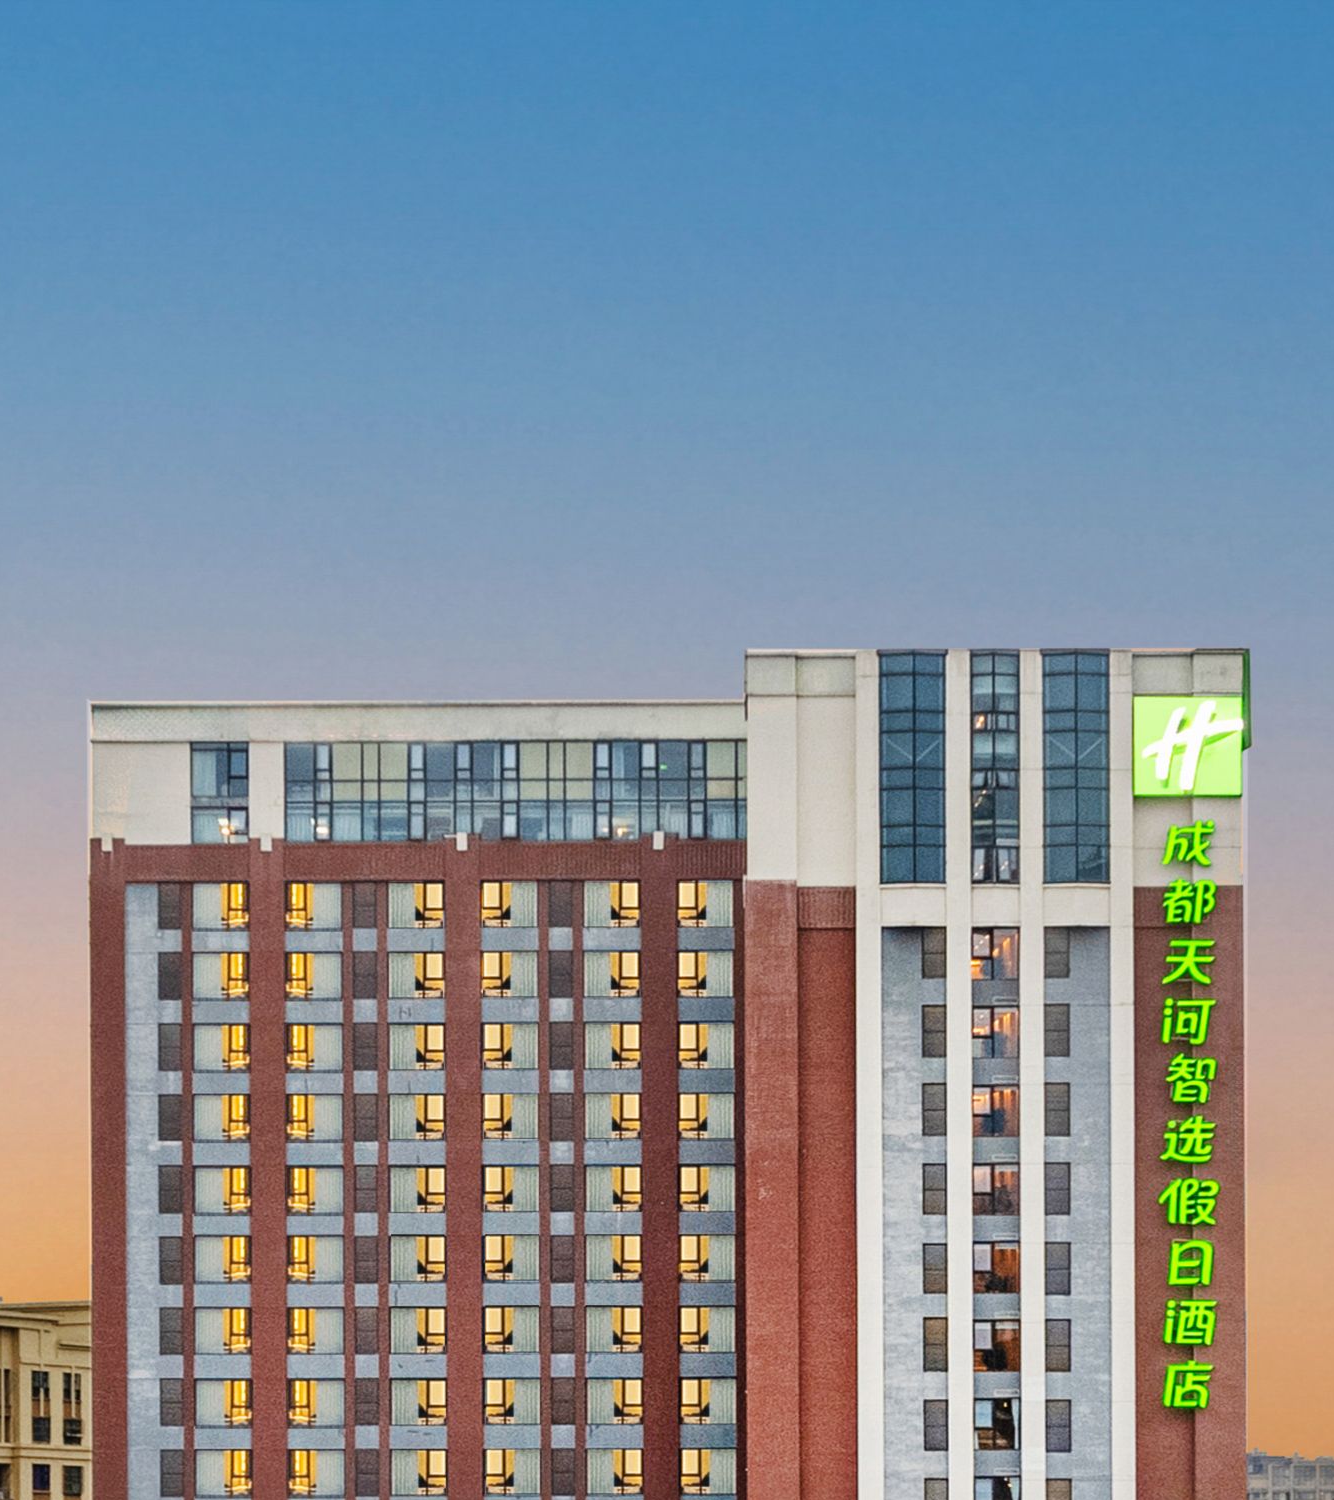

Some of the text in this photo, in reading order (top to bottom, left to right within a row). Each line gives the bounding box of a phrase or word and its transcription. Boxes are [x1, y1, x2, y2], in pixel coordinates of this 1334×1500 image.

[1159, 820, 1220, 1411] 成都天河智选假日酒店
